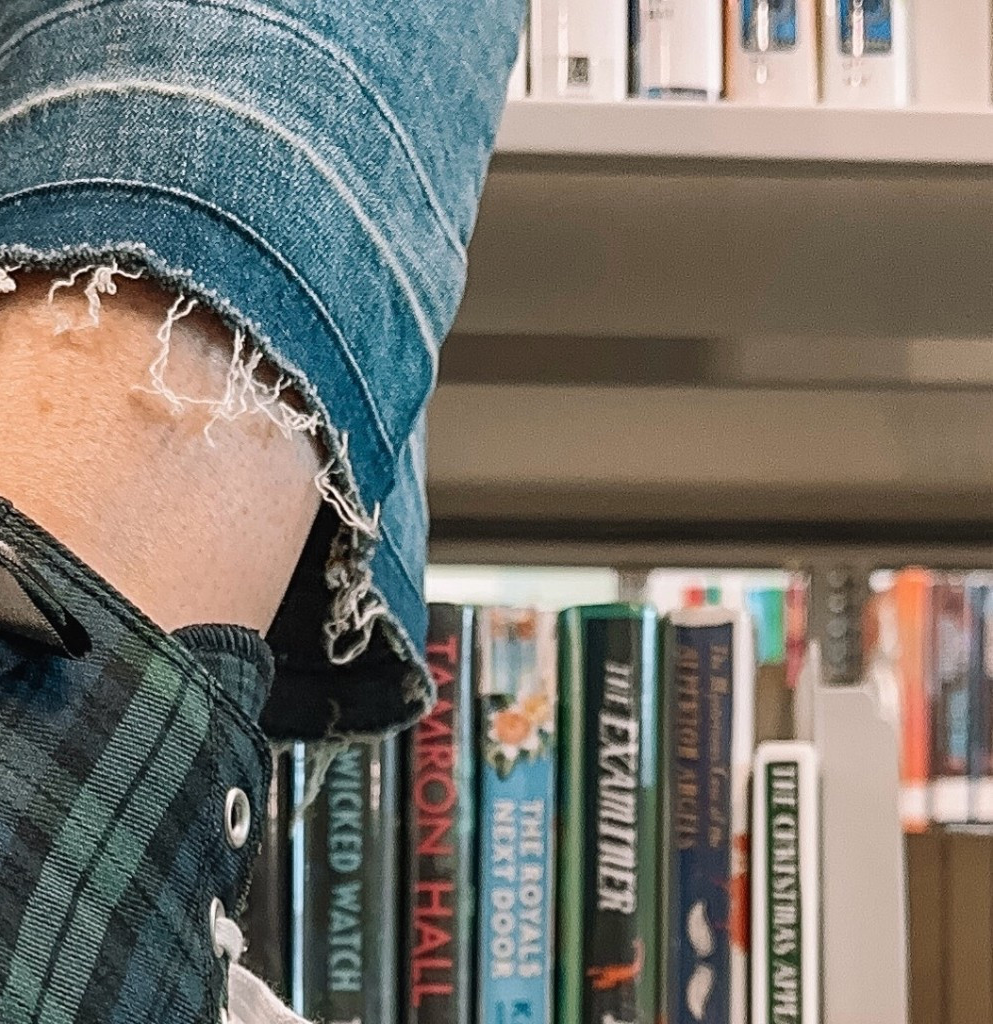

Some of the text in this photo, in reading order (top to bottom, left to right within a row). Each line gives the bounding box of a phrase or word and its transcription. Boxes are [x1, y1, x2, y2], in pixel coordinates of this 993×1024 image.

[327, 748, 363, 873] WICKED
[409, 633, 460, 1009] TAMRON HALL
[490, 799, 516, 980] NEXT DOOR
[517, 798, 544, 980] THE ROYALS
[597, 709, 639, 915] EXAMINER
[329, 879, 363, 992] WATCH
